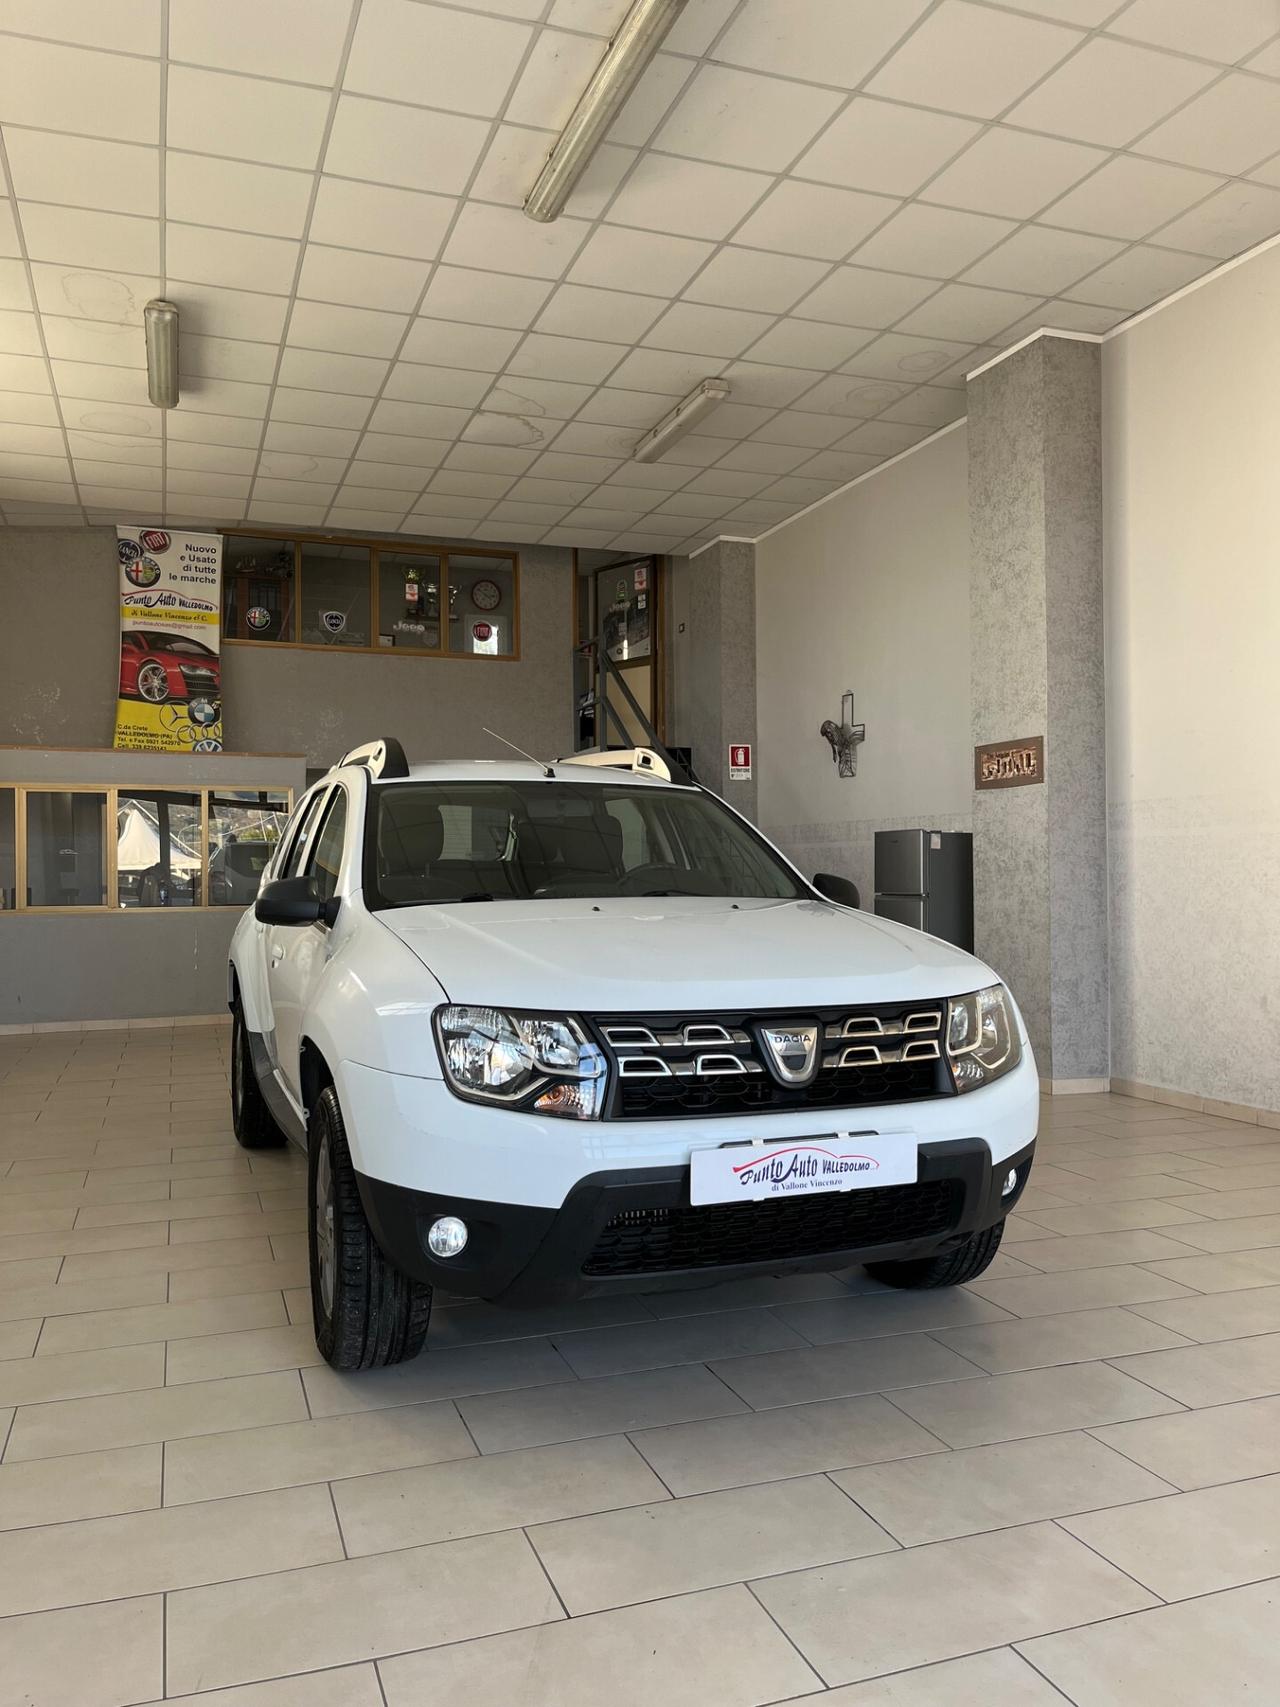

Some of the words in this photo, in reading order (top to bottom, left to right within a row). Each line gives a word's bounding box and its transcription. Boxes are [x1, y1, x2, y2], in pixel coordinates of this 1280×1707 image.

[145, 533, 164, 548] FIAT
[185, 543, 217, 554] Nuovo
[188, 554, 217, 564] Usato
[182, 564, 192, 572] di
[194, 565, 217, 575] tutte
[180, 575, 217, 585] marche
[124, 594, 152, 606] Punto
[144, 592, 177, 608] Auto
[178, 599, 213, 612] VALLEDOLMO
[140, 609, 163, 618] Vallone
[165, 612, 192, 620] Vincenzo
[774, 1034, 812, 1043] DACIA
[740, 1158, 783, 1185] Punto
[771, 1154, 818, 1183] Auto
[822, 1159, 870, 1174] VALLEDOLMO
[771, 1184, 779, 1192] di
[781, 1181, 808, 1191] Vallone
[810, 1179, 843, 1189] Vincenzo
